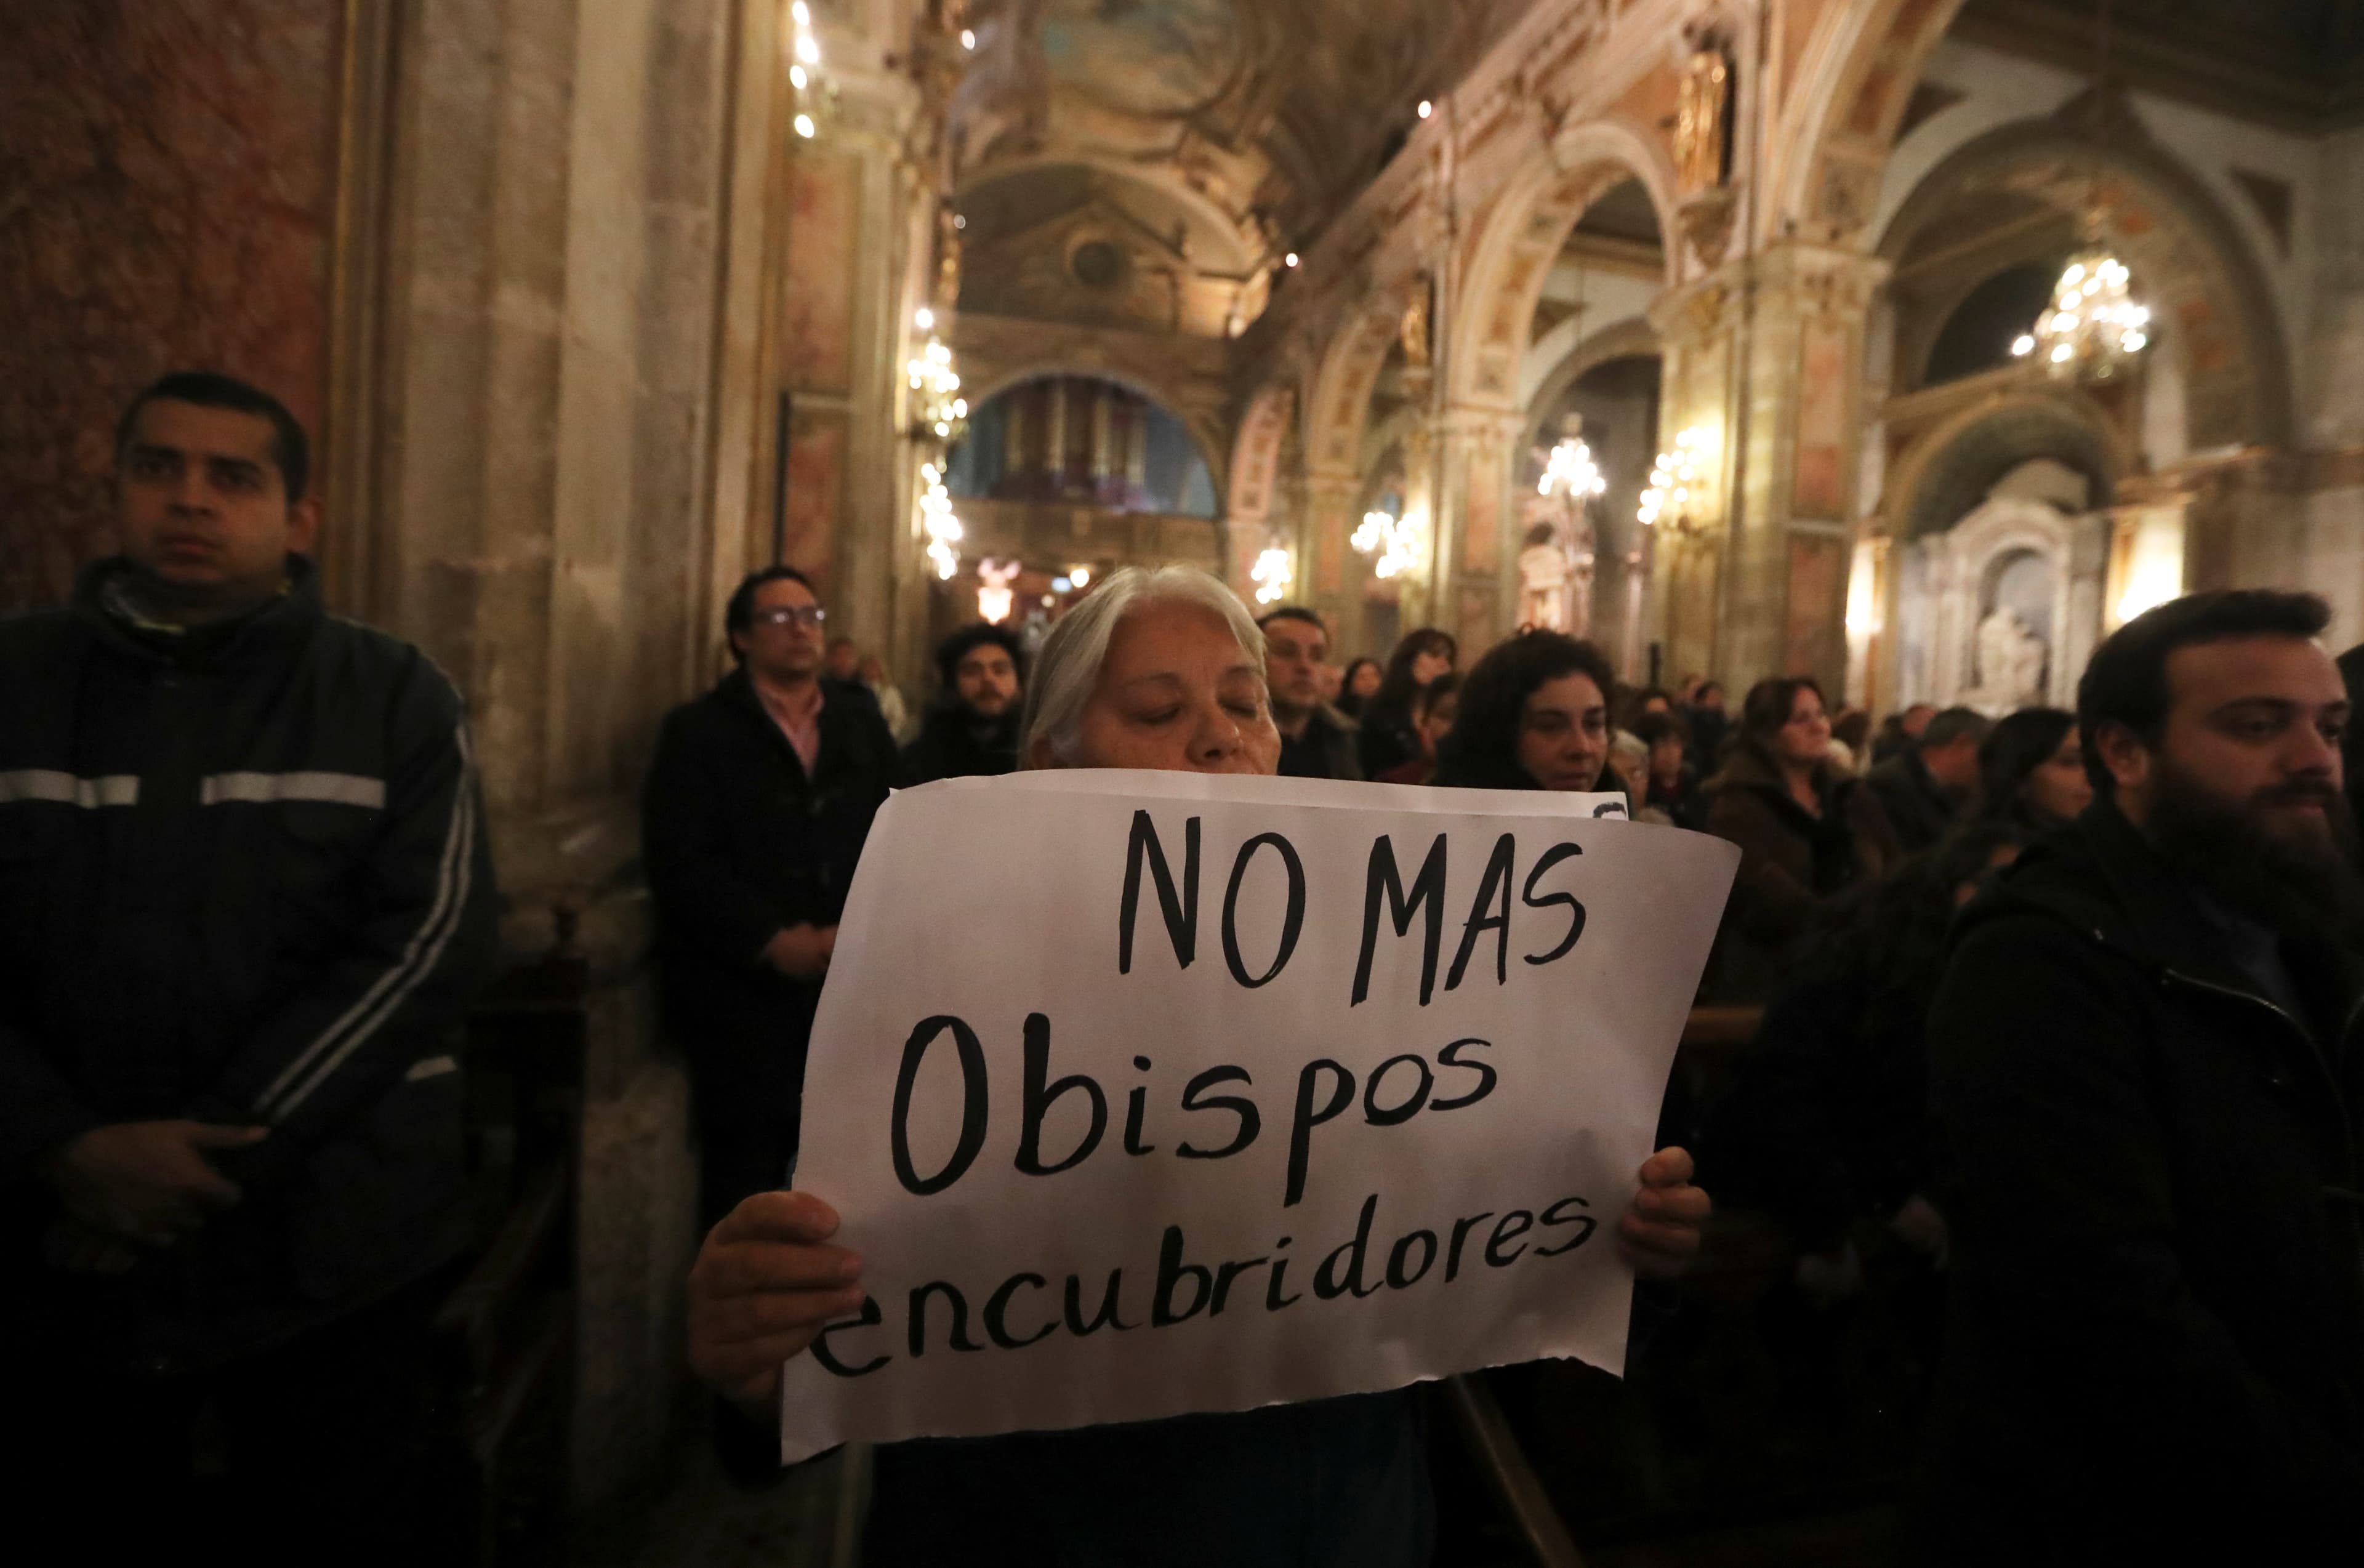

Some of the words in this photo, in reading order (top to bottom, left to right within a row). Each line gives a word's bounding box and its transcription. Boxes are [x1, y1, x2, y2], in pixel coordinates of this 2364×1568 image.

[1119, 810, 1305, 989] NO
[1351, 832, 1586, 1006] MAS
[891, 1012, 1498, 1207] Obispos
[810, 1194, 1598, 1377] encubridores
